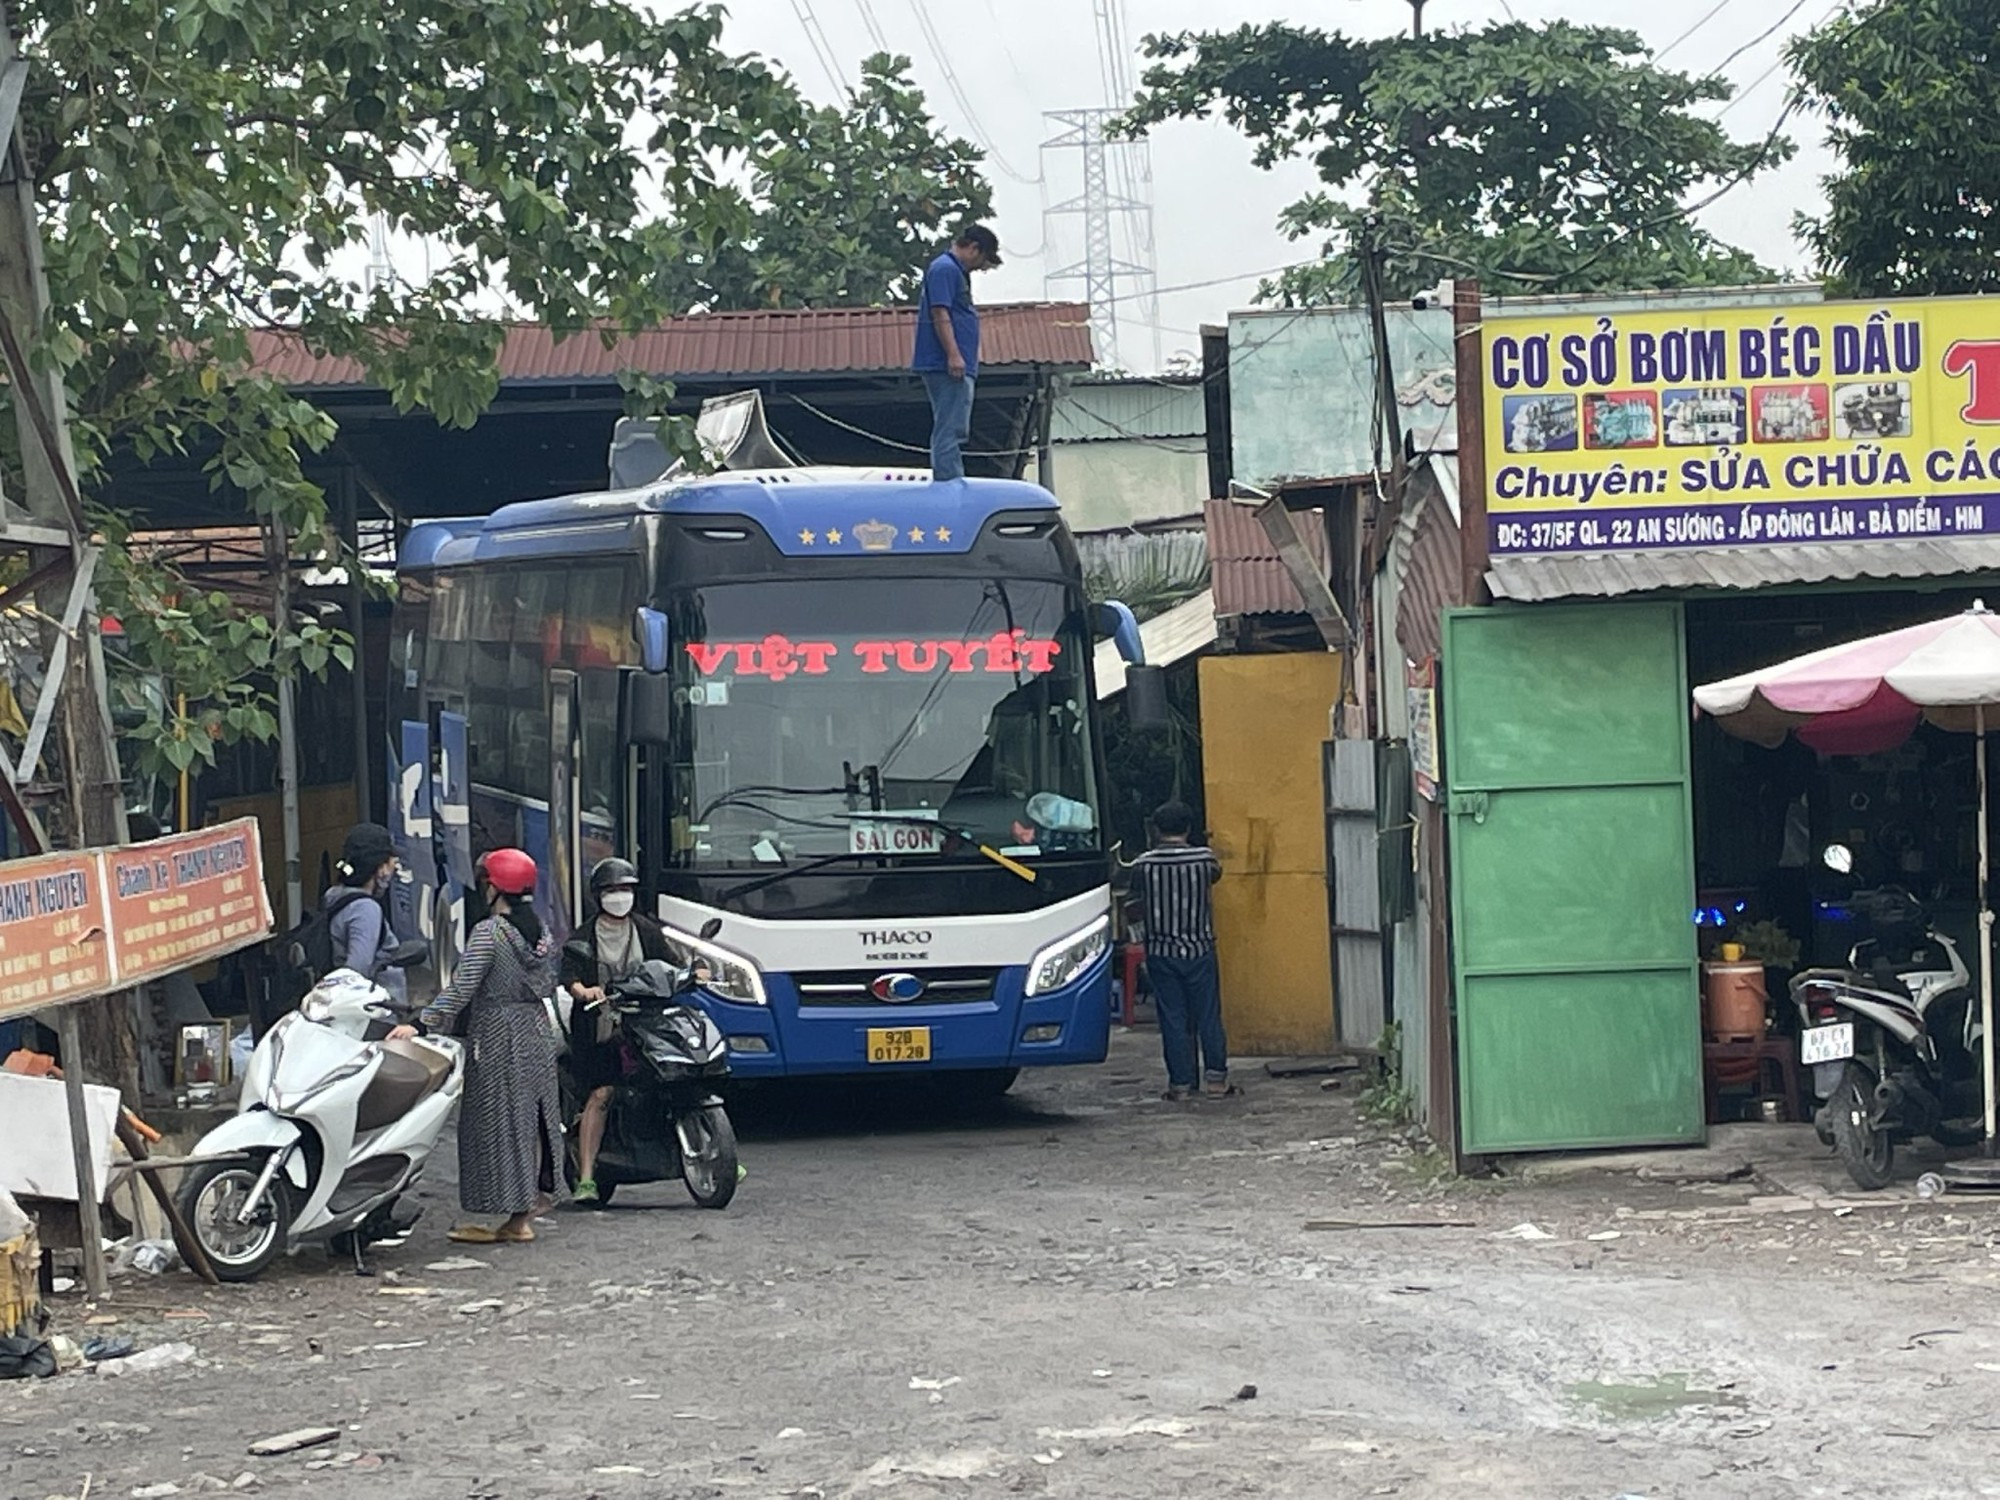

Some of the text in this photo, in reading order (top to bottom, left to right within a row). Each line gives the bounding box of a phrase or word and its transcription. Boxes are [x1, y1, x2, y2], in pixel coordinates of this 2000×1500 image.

[1492, 310, 1921, 388] CƠ SỞ BƠM BÉC DẦU
[1495, 463, 1667, 503] Chuyên:
[1680, 447, 1770, 492] SỬA
[1784, 444, 1911, 488] CHỮA
[1497, 523, 1528, 548] ĐC:
[1531, 520, 1576, 549] 37/5F
[1579, 520, 1607, 546] QL.
[1611, 519, 1633, 544] 22
[1636, 517, 1661, 543] AN
[1664, 512, 1725, 542] SƯƠNG
[1738, 504, 1763, 539] ẤP
[1765, 508, 1816, 538] ĐÔNG
[1819, 506, 1856, 536] LÂN
[1896, 496, 1943, 533] ĐIỂM
[1955, 505, 1983, 530] HM
[685, 627, 1063, 681] VIỆT TUYẾT
[858, 930, 932, 945] THACO
